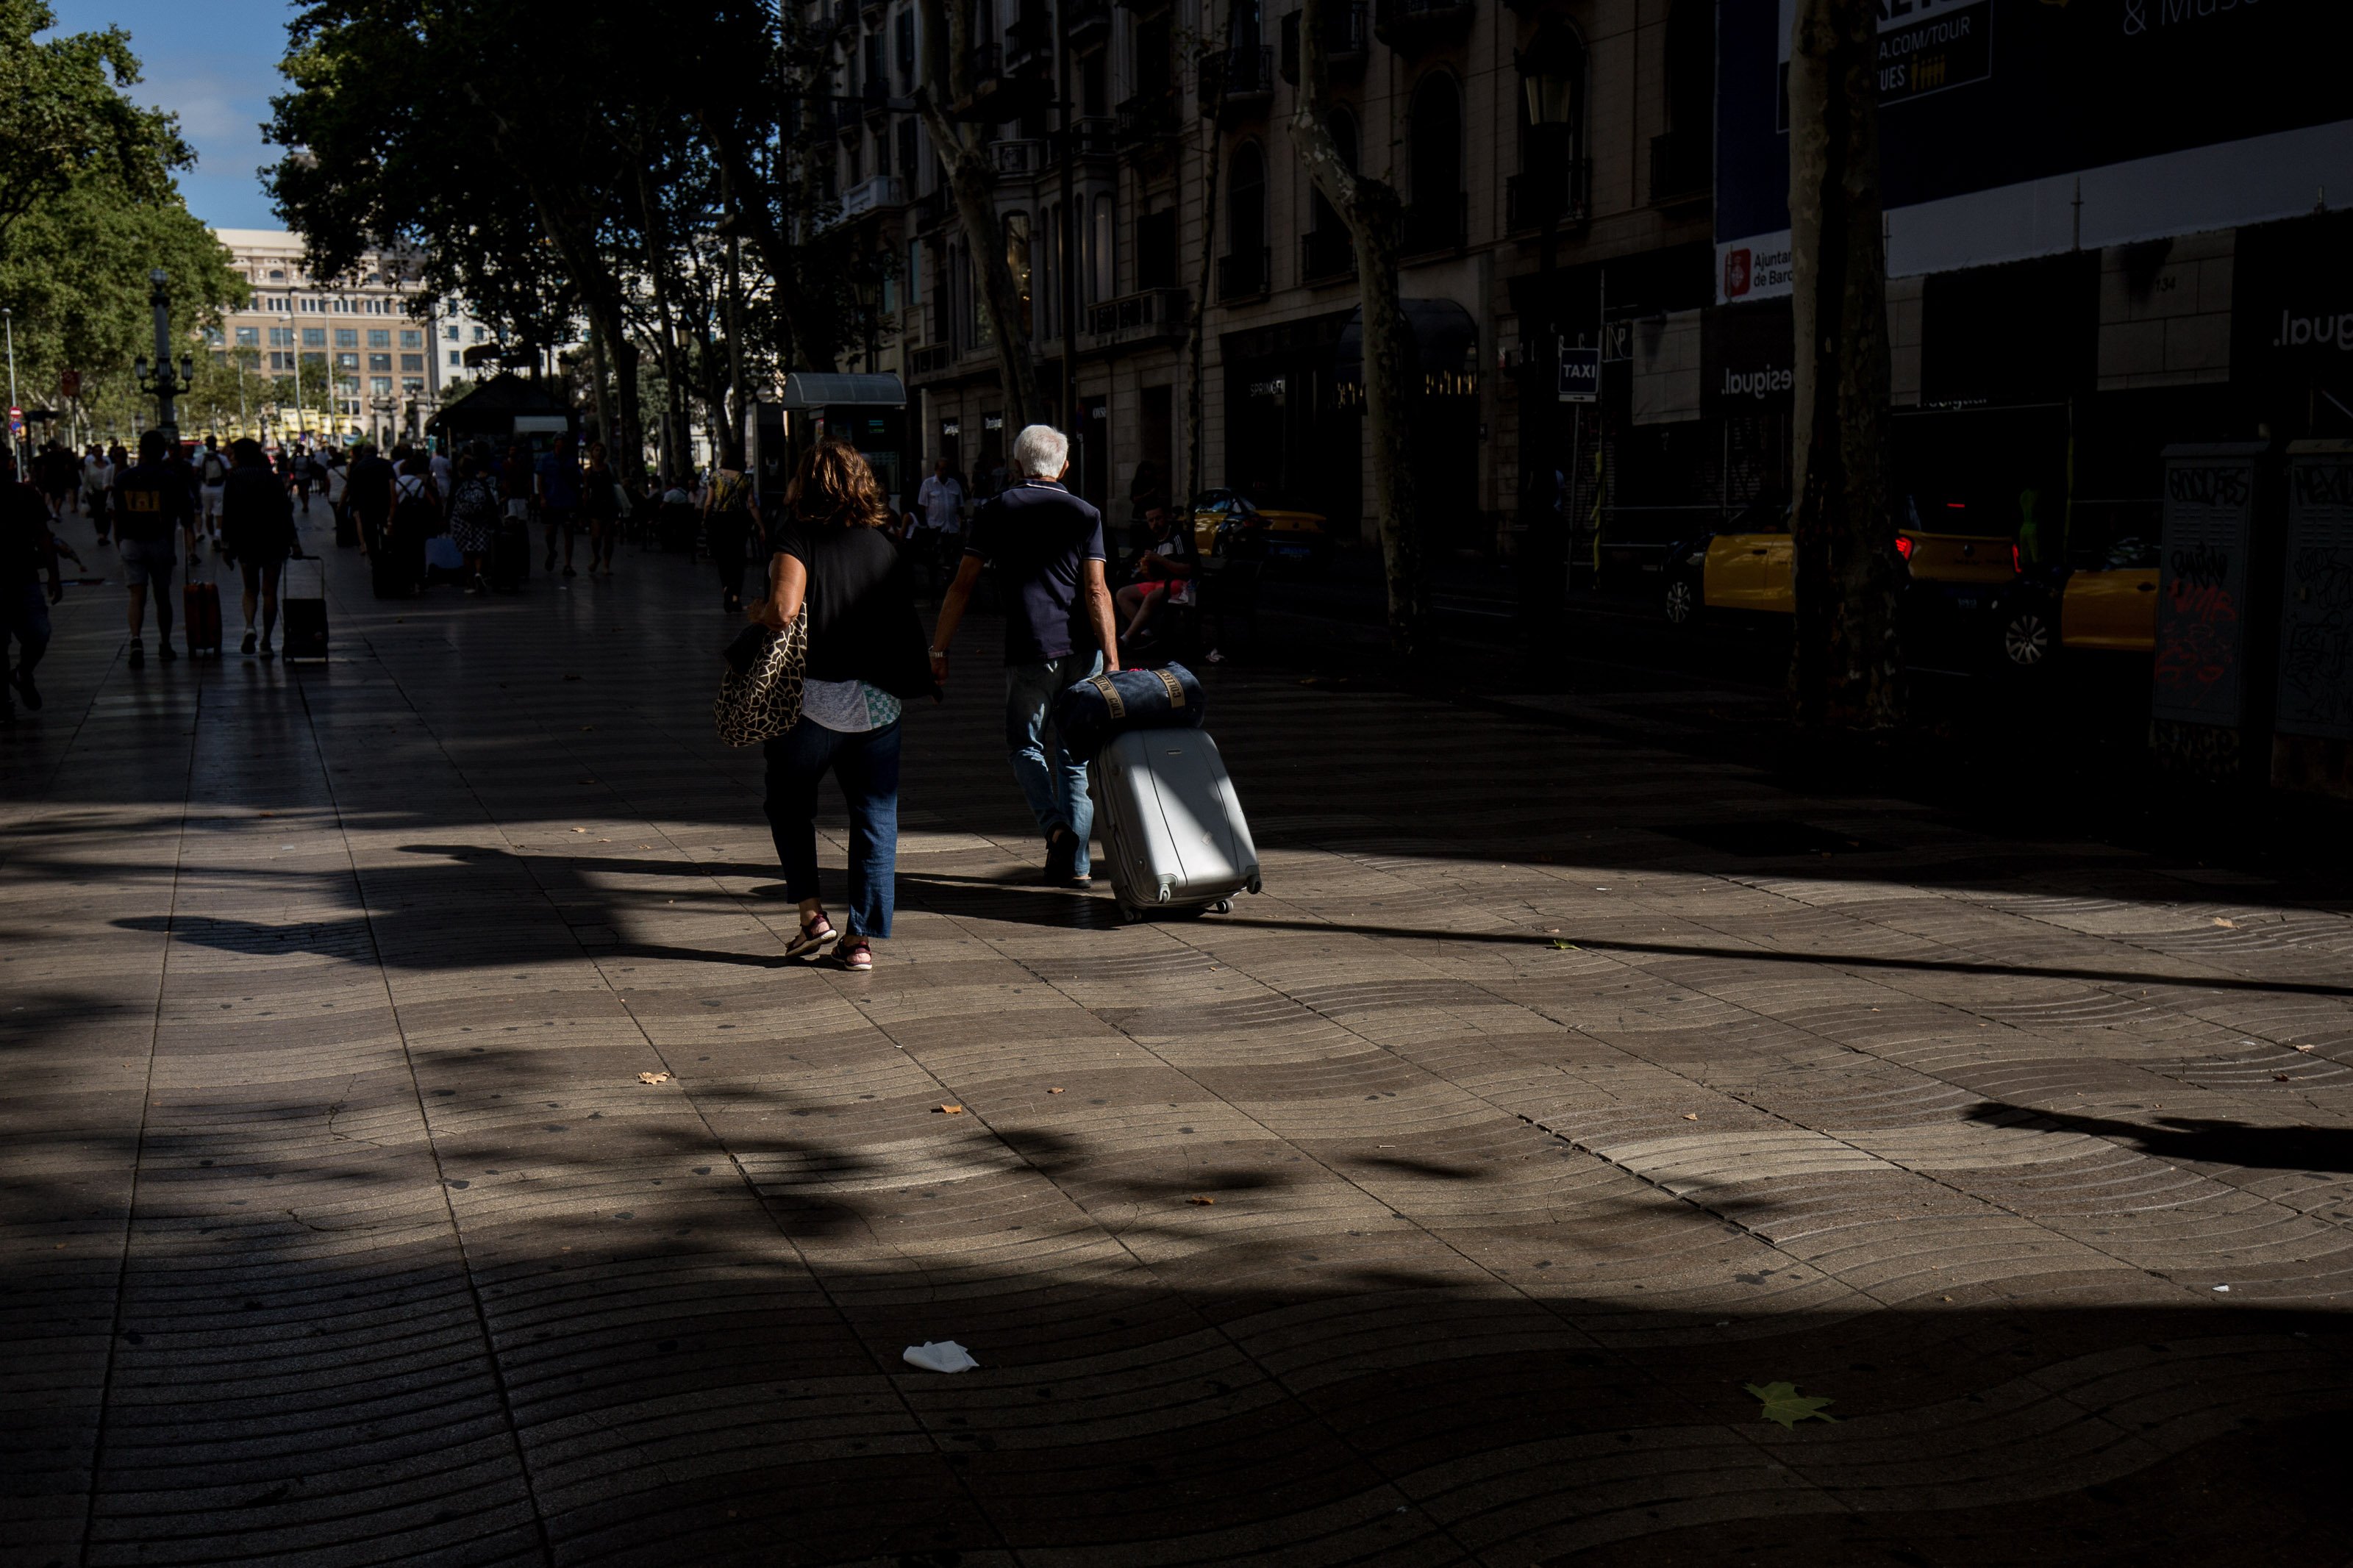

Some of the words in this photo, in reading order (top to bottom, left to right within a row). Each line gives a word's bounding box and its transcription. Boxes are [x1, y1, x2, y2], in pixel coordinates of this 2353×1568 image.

[1754, 271, 1767, 287] de
[2155, 276, 2176, 293] 134
[1563, 364, 1596, 379] TAXI
